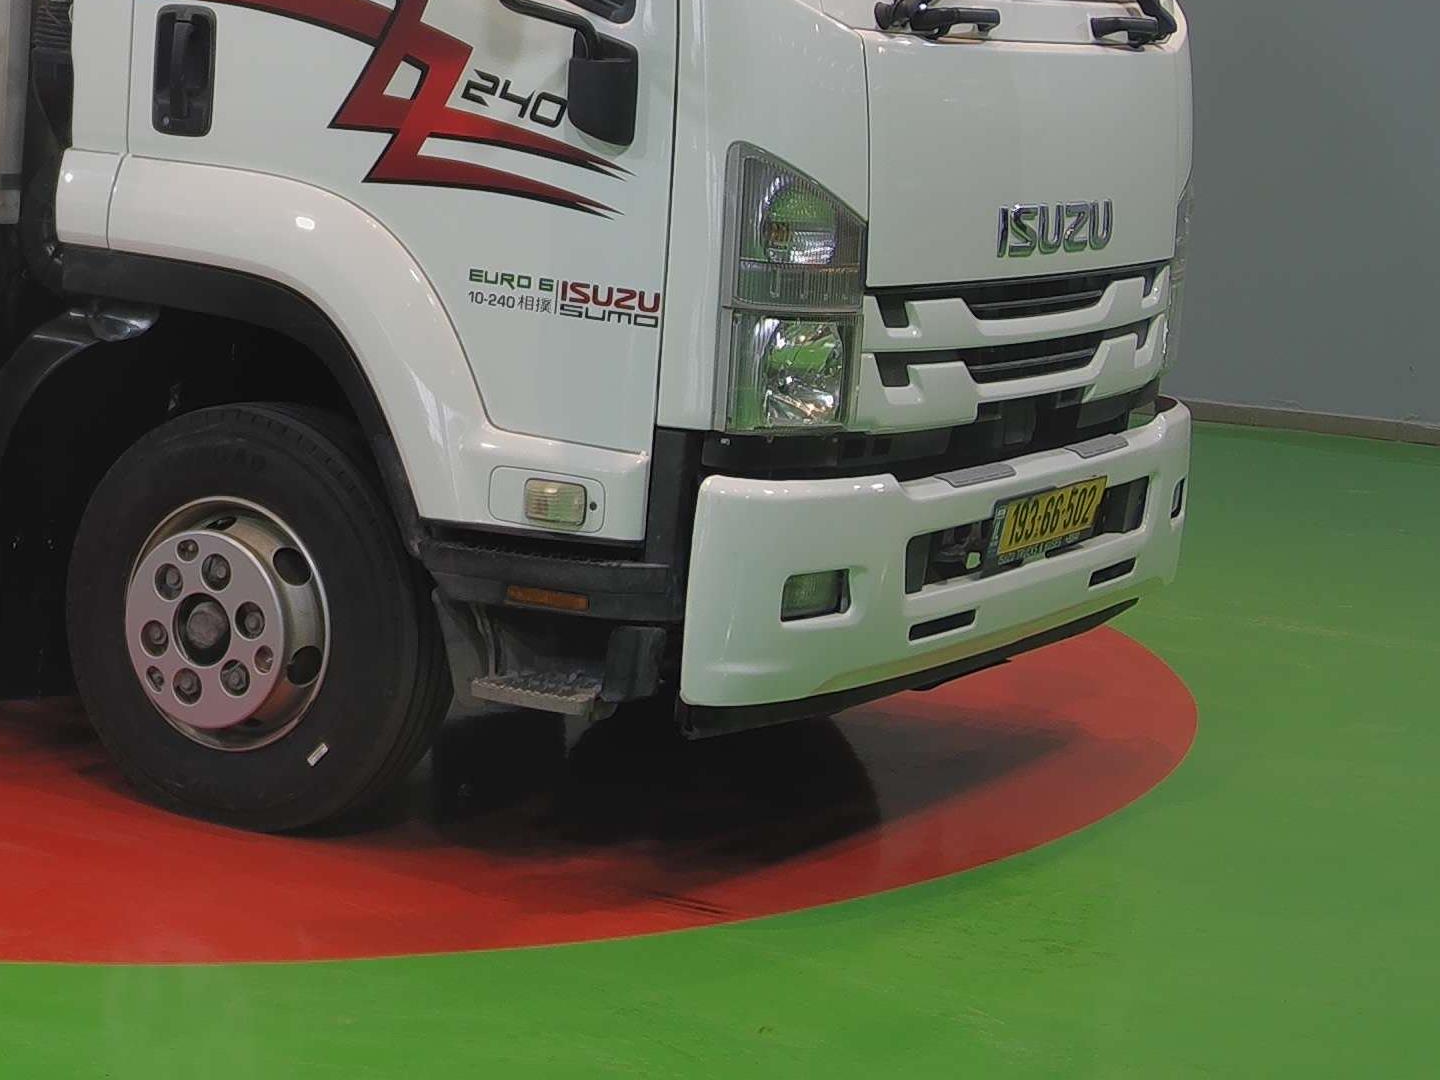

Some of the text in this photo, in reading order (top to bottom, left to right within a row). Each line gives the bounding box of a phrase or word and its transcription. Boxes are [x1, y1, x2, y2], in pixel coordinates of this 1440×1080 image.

[461, 69, 568, 128] 240
[997, 199, 1113, 258] ISUZU
[469, 268, 555, 292] EURO 6
[468, 290, 516, 309] 10-240
[561, 280, 660, 313] ISUZU
[560, 304, 659, 329] SUMO
